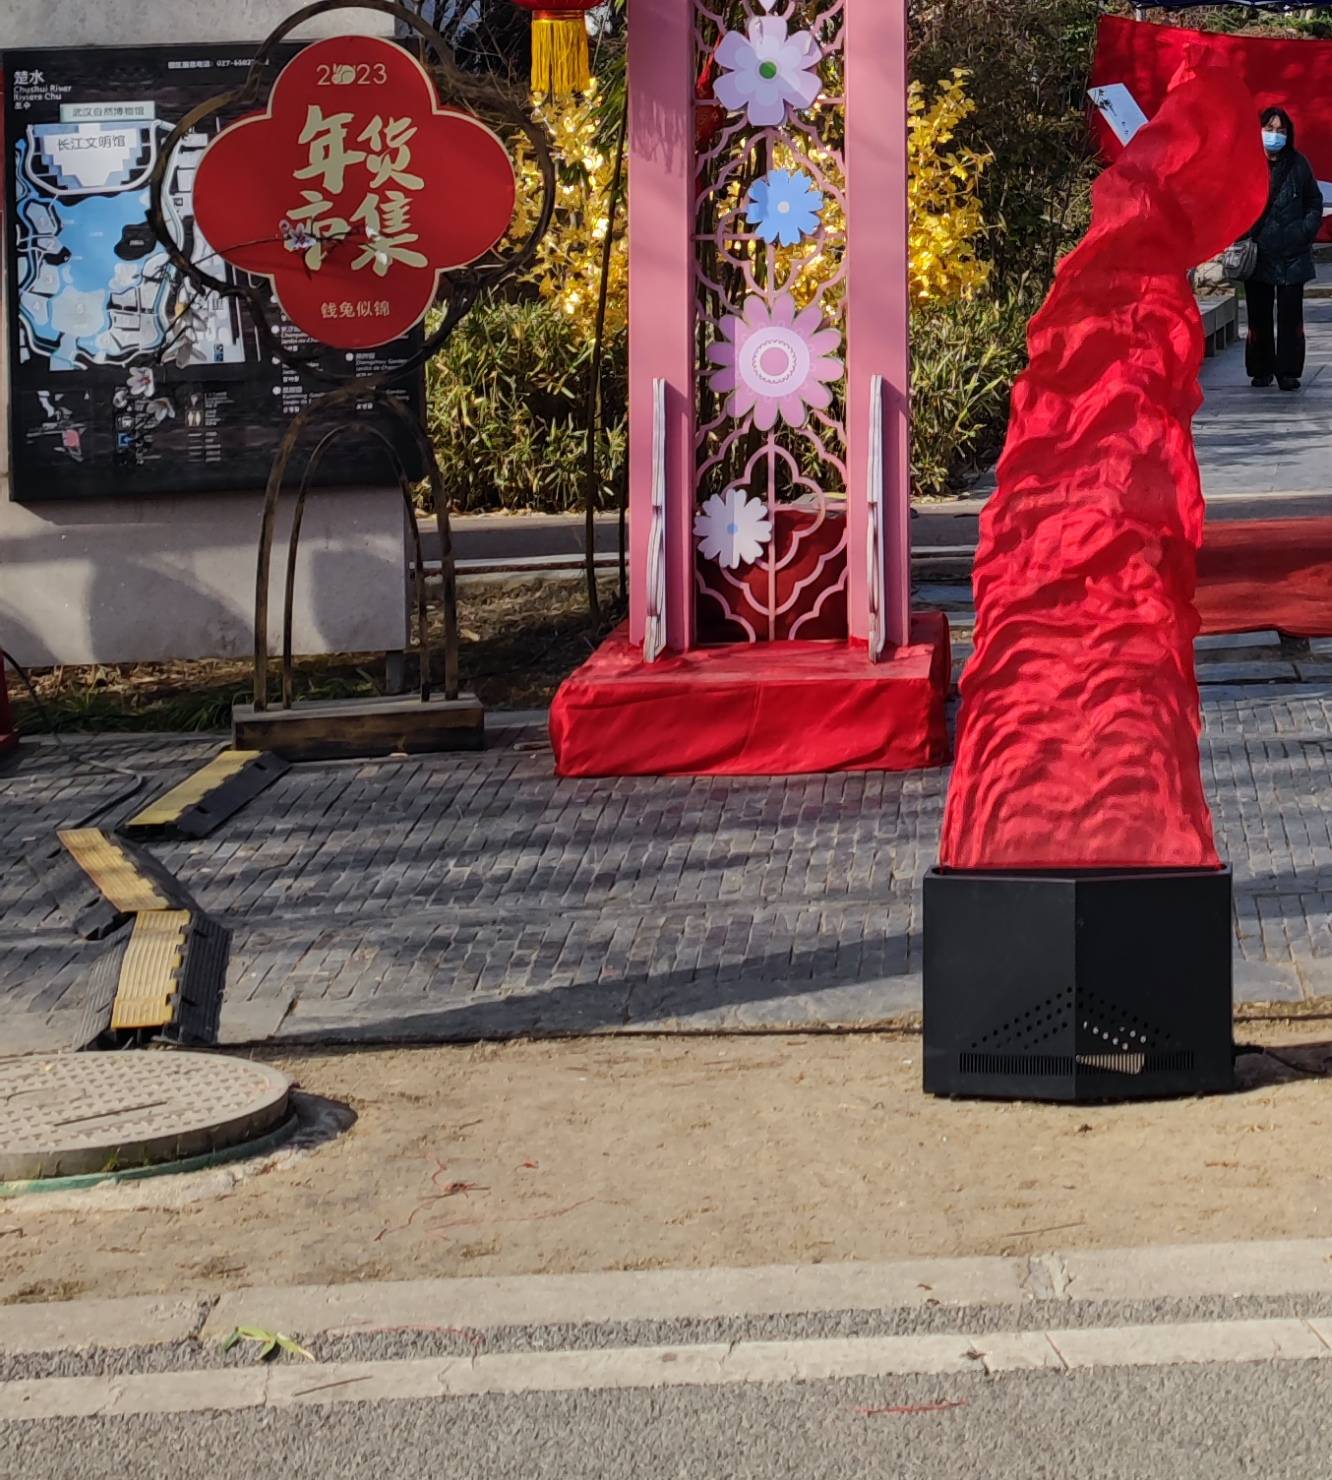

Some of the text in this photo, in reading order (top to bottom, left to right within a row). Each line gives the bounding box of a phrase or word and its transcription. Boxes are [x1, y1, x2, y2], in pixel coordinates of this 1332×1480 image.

[14, 69, 45, 85] 楚水
[44, 92, 62, 100] Chu
[49, 84, 72, 92] River
[72, 106, 145, 117] 武汉自然博物馆
[58, 135, 127, 151] 长江文明馆
[293, 105, 424, 194] 年货
[284, 191, 428, 277] 市集
[321, 300, 390, 319] 钱兔似锦
